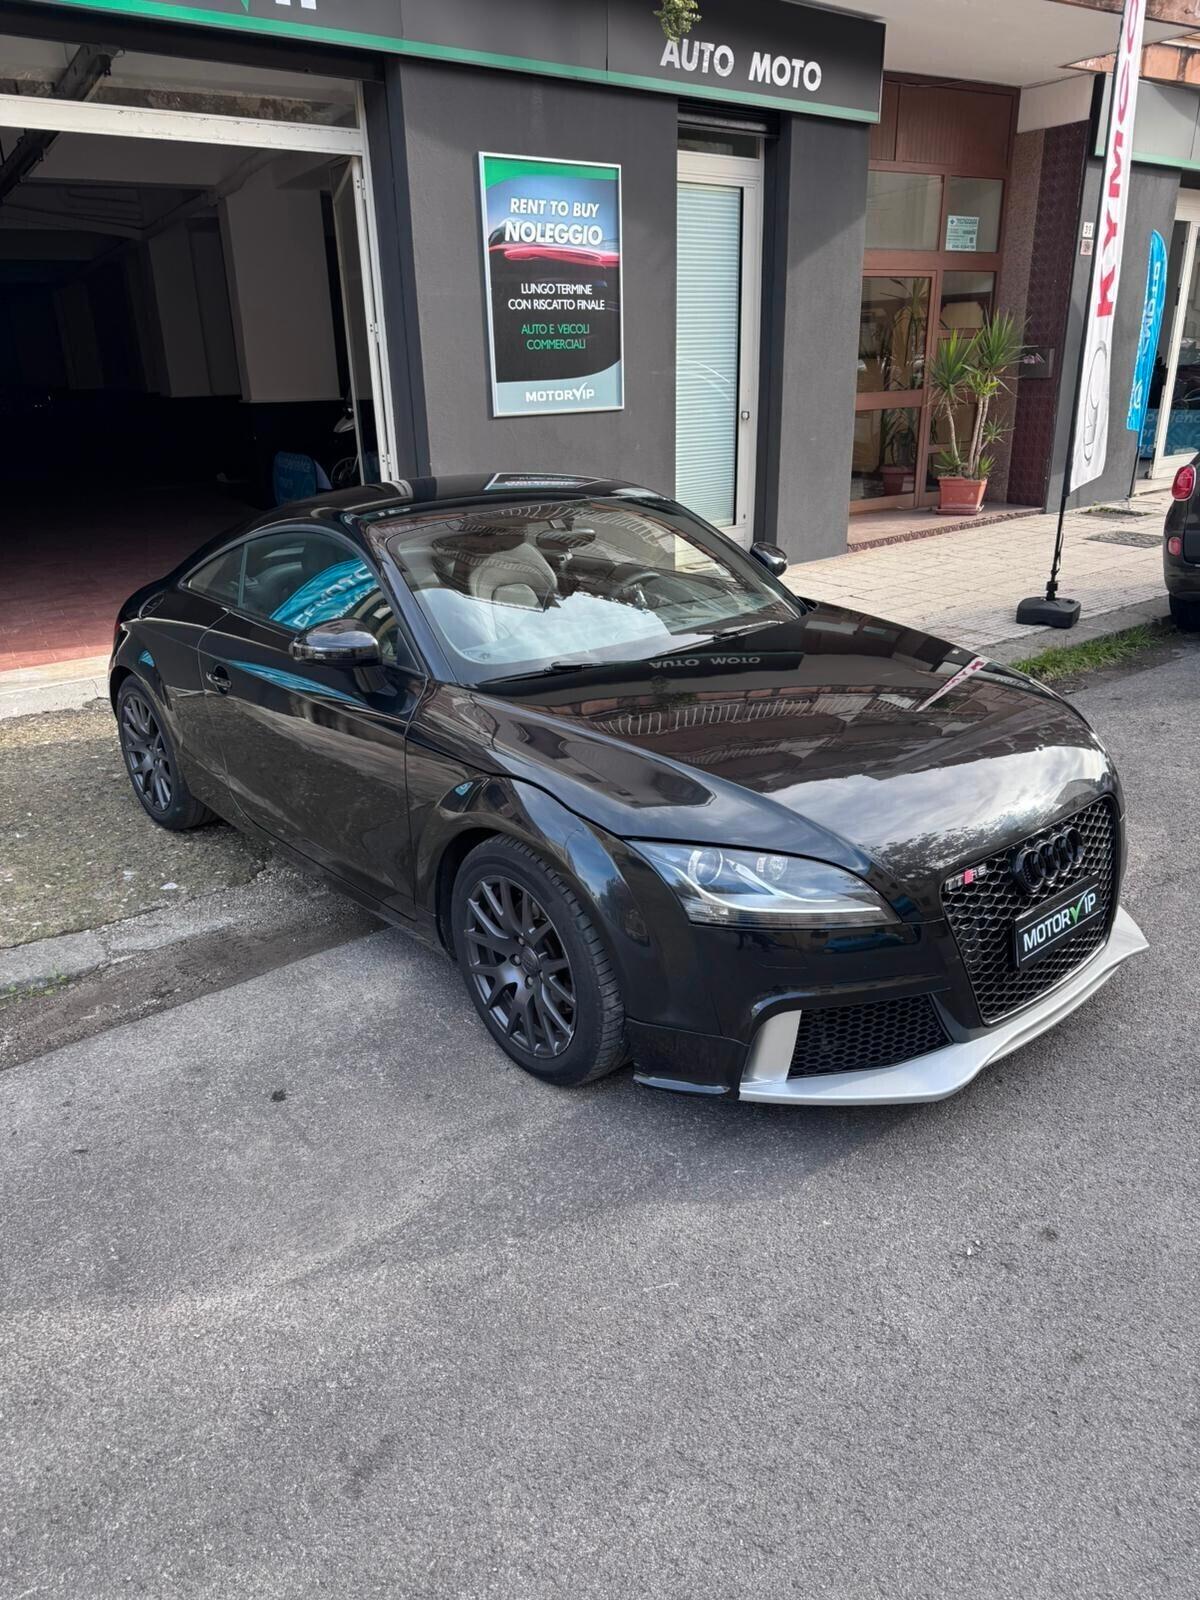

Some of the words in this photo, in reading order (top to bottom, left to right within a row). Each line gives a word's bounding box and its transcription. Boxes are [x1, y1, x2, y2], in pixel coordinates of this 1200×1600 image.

[660, 37, 735, 77] AUTO
[748, 52, 822, 92] MOTO
[1097, 0, 1139, 317] KYMCO
[510, 197, 547, 215] RENT
[550, 200, 569, 217] TO
[573, 202, 600, 218] BUY
[504, 220, 603, 246] NOLEGGIO
[520, 283, 555, 295] LUNGO
[555, 284, 593, 295] TERMINE
[507, 299, 531, 310] CON
[533, 299, 576, 311] RISCATTO
[576, 299, 606, 311] FINALE
[521, 323, 548, 334] AUTO
[549, 323, 555, 334] E
[557, 323, 590, 334] VEICOLI
[526, 338, 586, 350] COMMERCIALI
[525, 381, 595, 402] MOTORVIP
[1022, 889, 1096, 952] MOTORVIP
